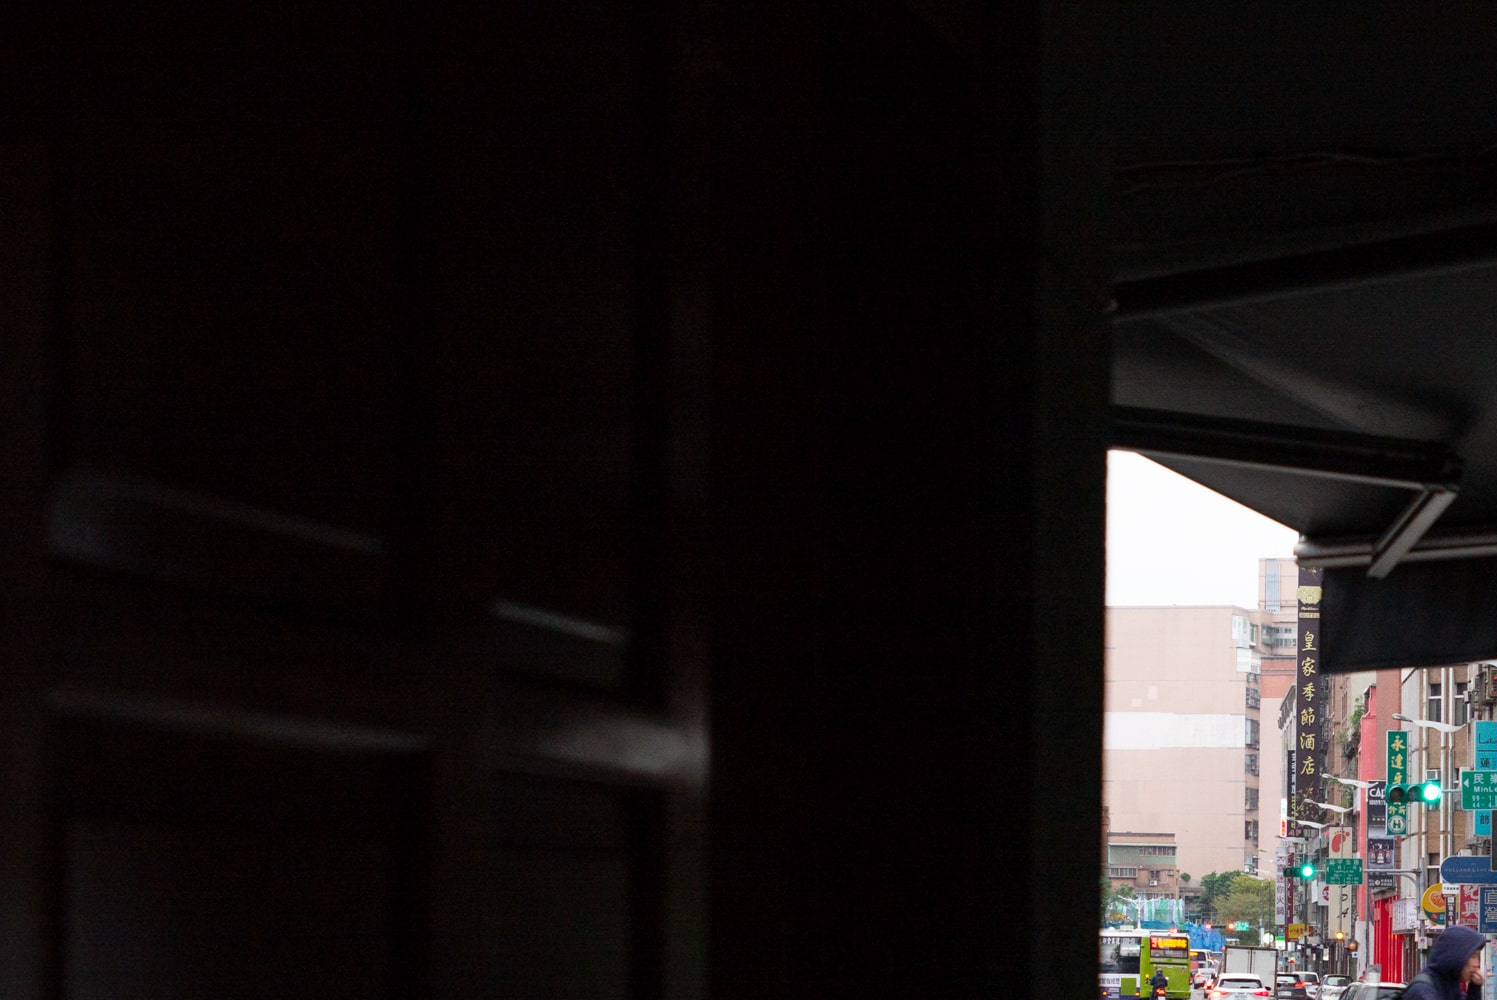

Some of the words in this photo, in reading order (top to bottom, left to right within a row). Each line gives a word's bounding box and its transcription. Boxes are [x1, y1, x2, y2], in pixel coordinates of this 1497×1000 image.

[1301, 631, 1317, 776] 皇家季節酒店
